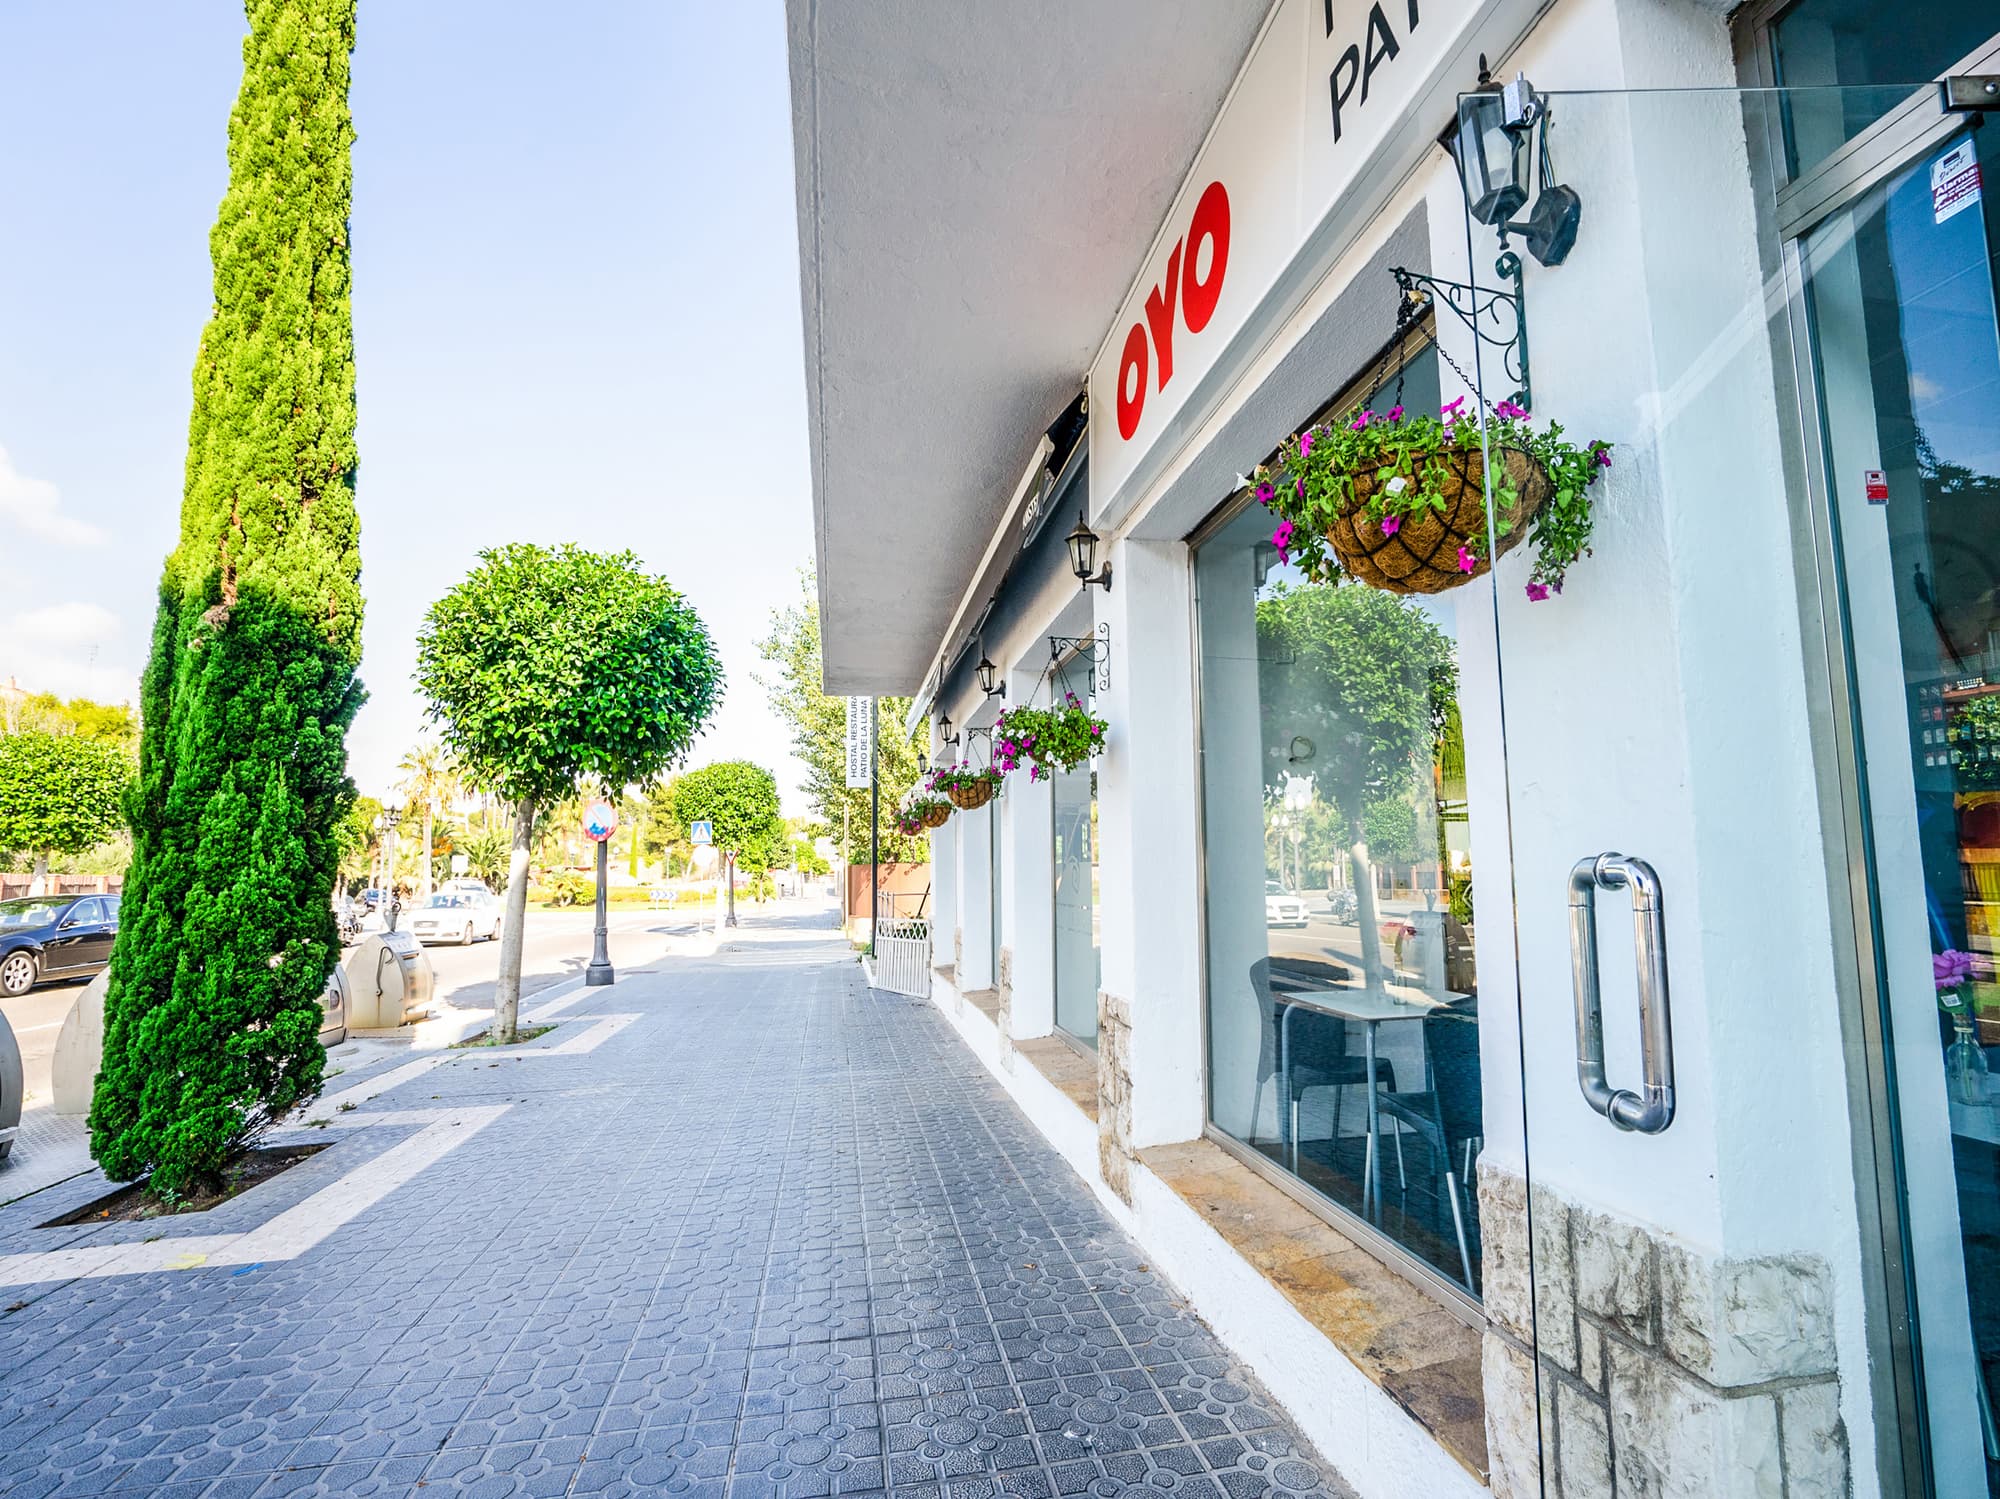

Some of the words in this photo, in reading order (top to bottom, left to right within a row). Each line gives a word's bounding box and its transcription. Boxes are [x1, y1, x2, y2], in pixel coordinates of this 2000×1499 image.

[1116, 181, 1230, 440] OYO
[860, 699, 868, 724] LUNA
[860, 725, 868, 737] LA
[860, 738, 868, 751] DE
[850, 743, 858, 778] HOSTAL
[860, 753, 868, 778] PATIO
